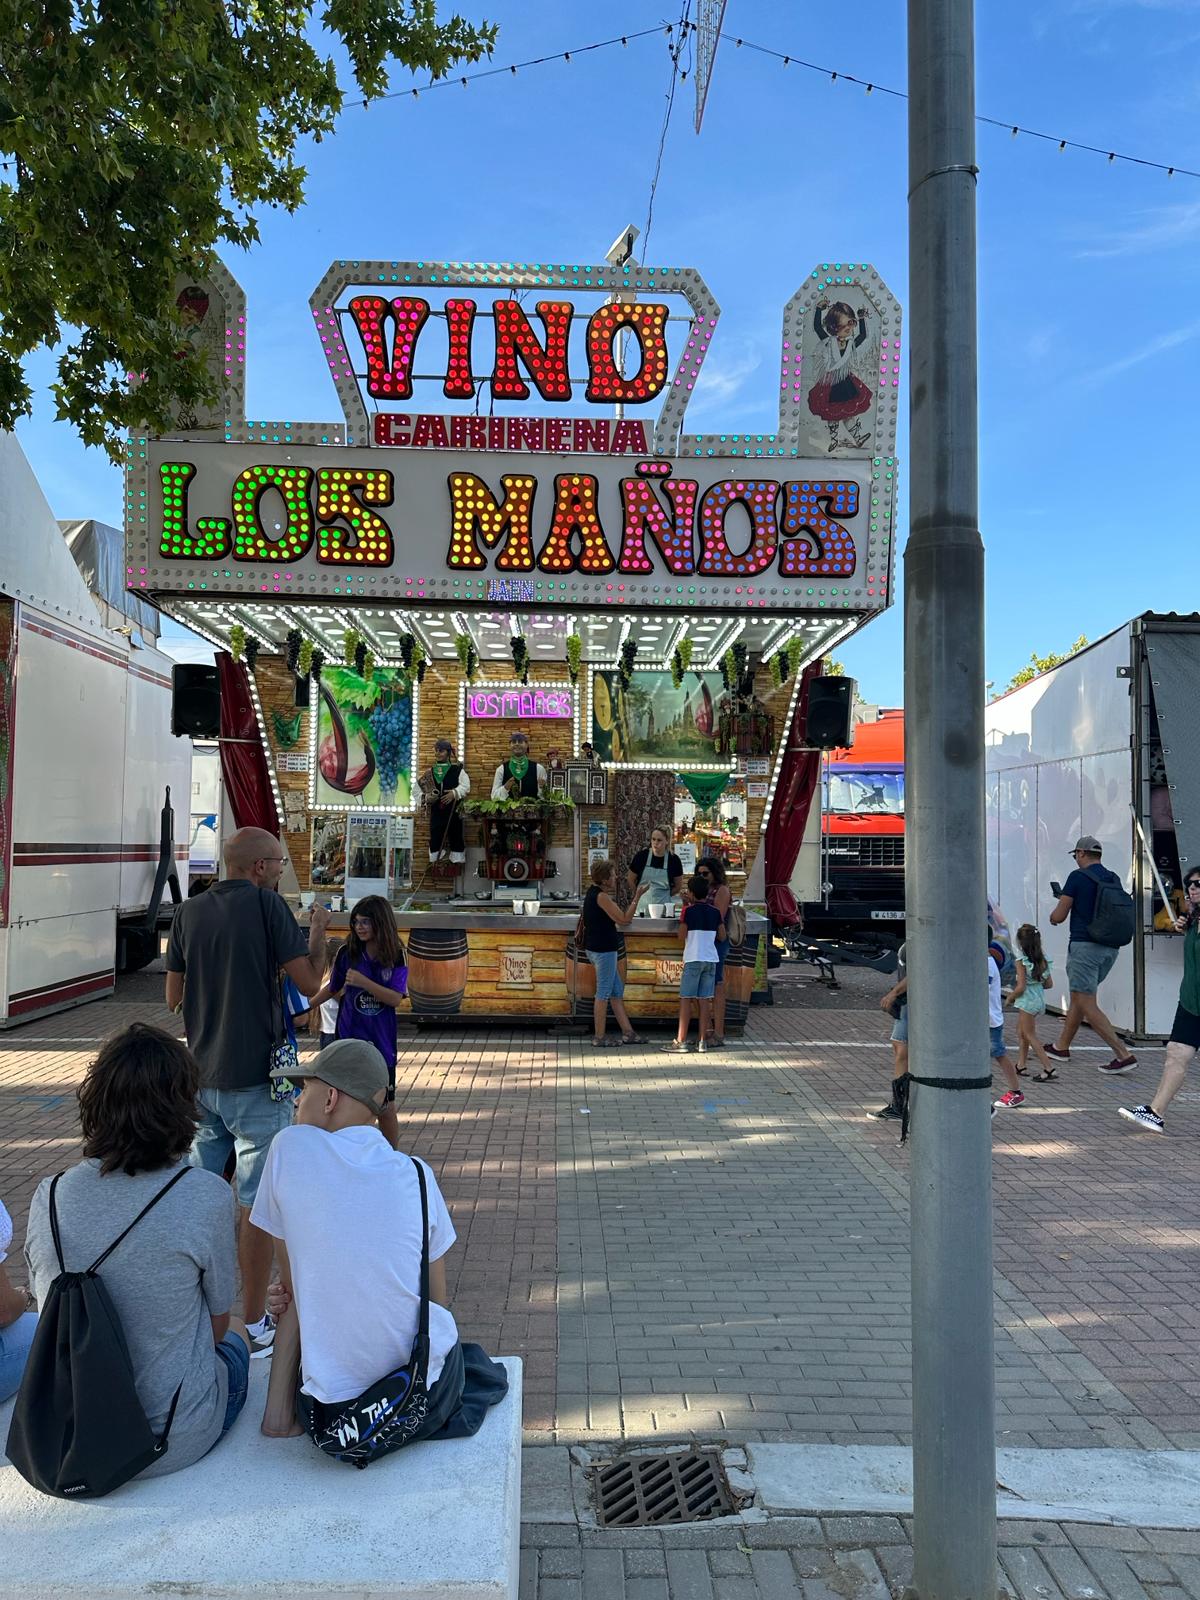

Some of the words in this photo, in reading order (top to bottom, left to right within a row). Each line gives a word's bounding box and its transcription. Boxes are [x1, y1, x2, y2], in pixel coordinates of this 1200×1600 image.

[349, 295, 669, 403] VINO
[159, 462, 394, 567] LOS
[448, 462, 860, 577] MAÑOS
[502, 956, 528, 971] Vinos
[338, 1416, 360, 1449] IN
